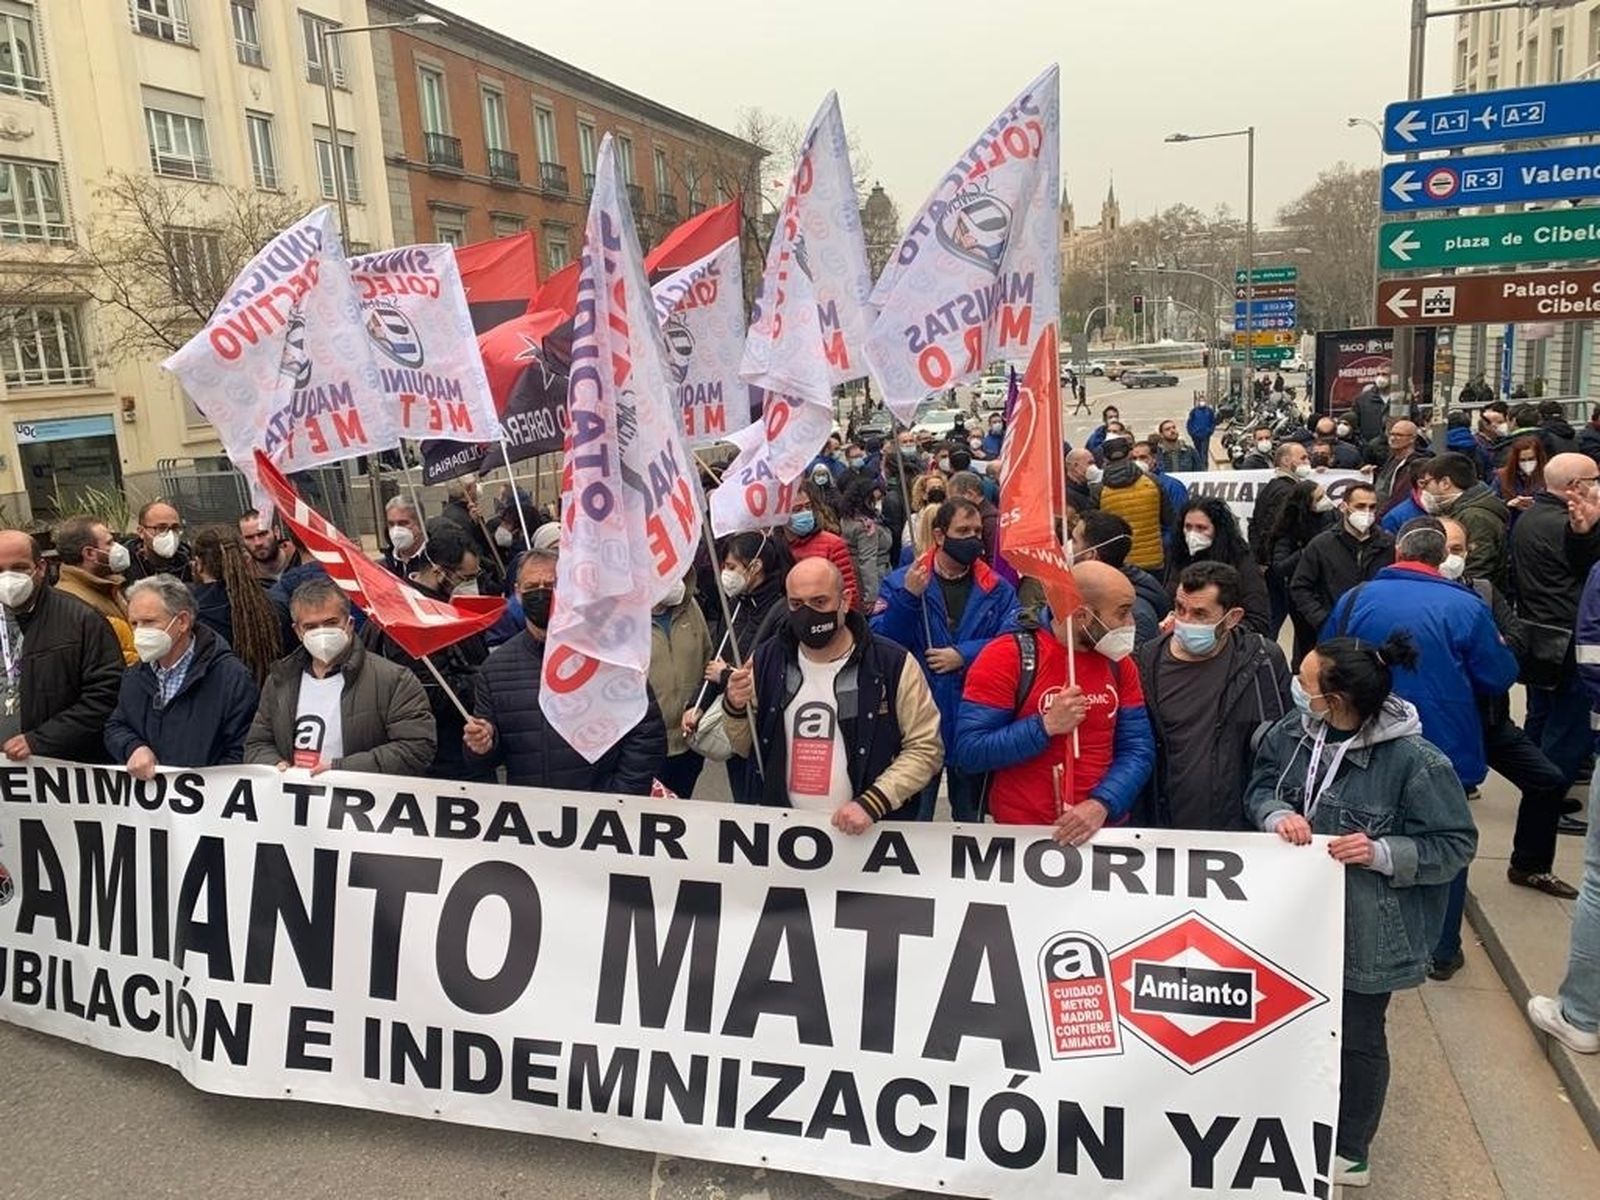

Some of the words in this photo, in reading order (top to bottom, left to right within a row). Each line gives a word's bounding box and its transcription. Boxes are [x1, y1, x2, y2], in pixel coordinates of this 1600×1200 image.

[1436, 114, 1465, 130] A-1
[1506, 106, 1540, 122] A-2
[1466, 172, 1498, 187] R-3
[1445, 236, 1490, 251] plaza
[1501, 232, 1523, 246] de
[1503, 281, 1578, 297] Palacio
[221, 779, 257, 821] A
[283, 782, 688, 860] TRABAJAR
[717, 819, 834, 872] NO
[863, 830, 921, 874] A
[951, 835, 1248, 901] MORIR
[16, 819, 541, 1014] AMIANTO
[595, 873, 1041, 1073] MATA
[1052, 941, 1096, 980] a
[1053, 984, 1103, 999] CUIDADO
[1139, 974, 1248, 1006] Amianto
[1060, 998, 1099, 1010] METRO
[1060, 1010, 1103, 1023] MADRID
[1056, 1022, 1112, 1037] CONTIENE
[1060, 1035, 1111, 1049] AMIANTO
[285, 1006, 334, 1071] E
[364, 1017, 1126, 1181] INDEMNIZACIÓN
[1165, 1111, 1333, 1200] YA!
